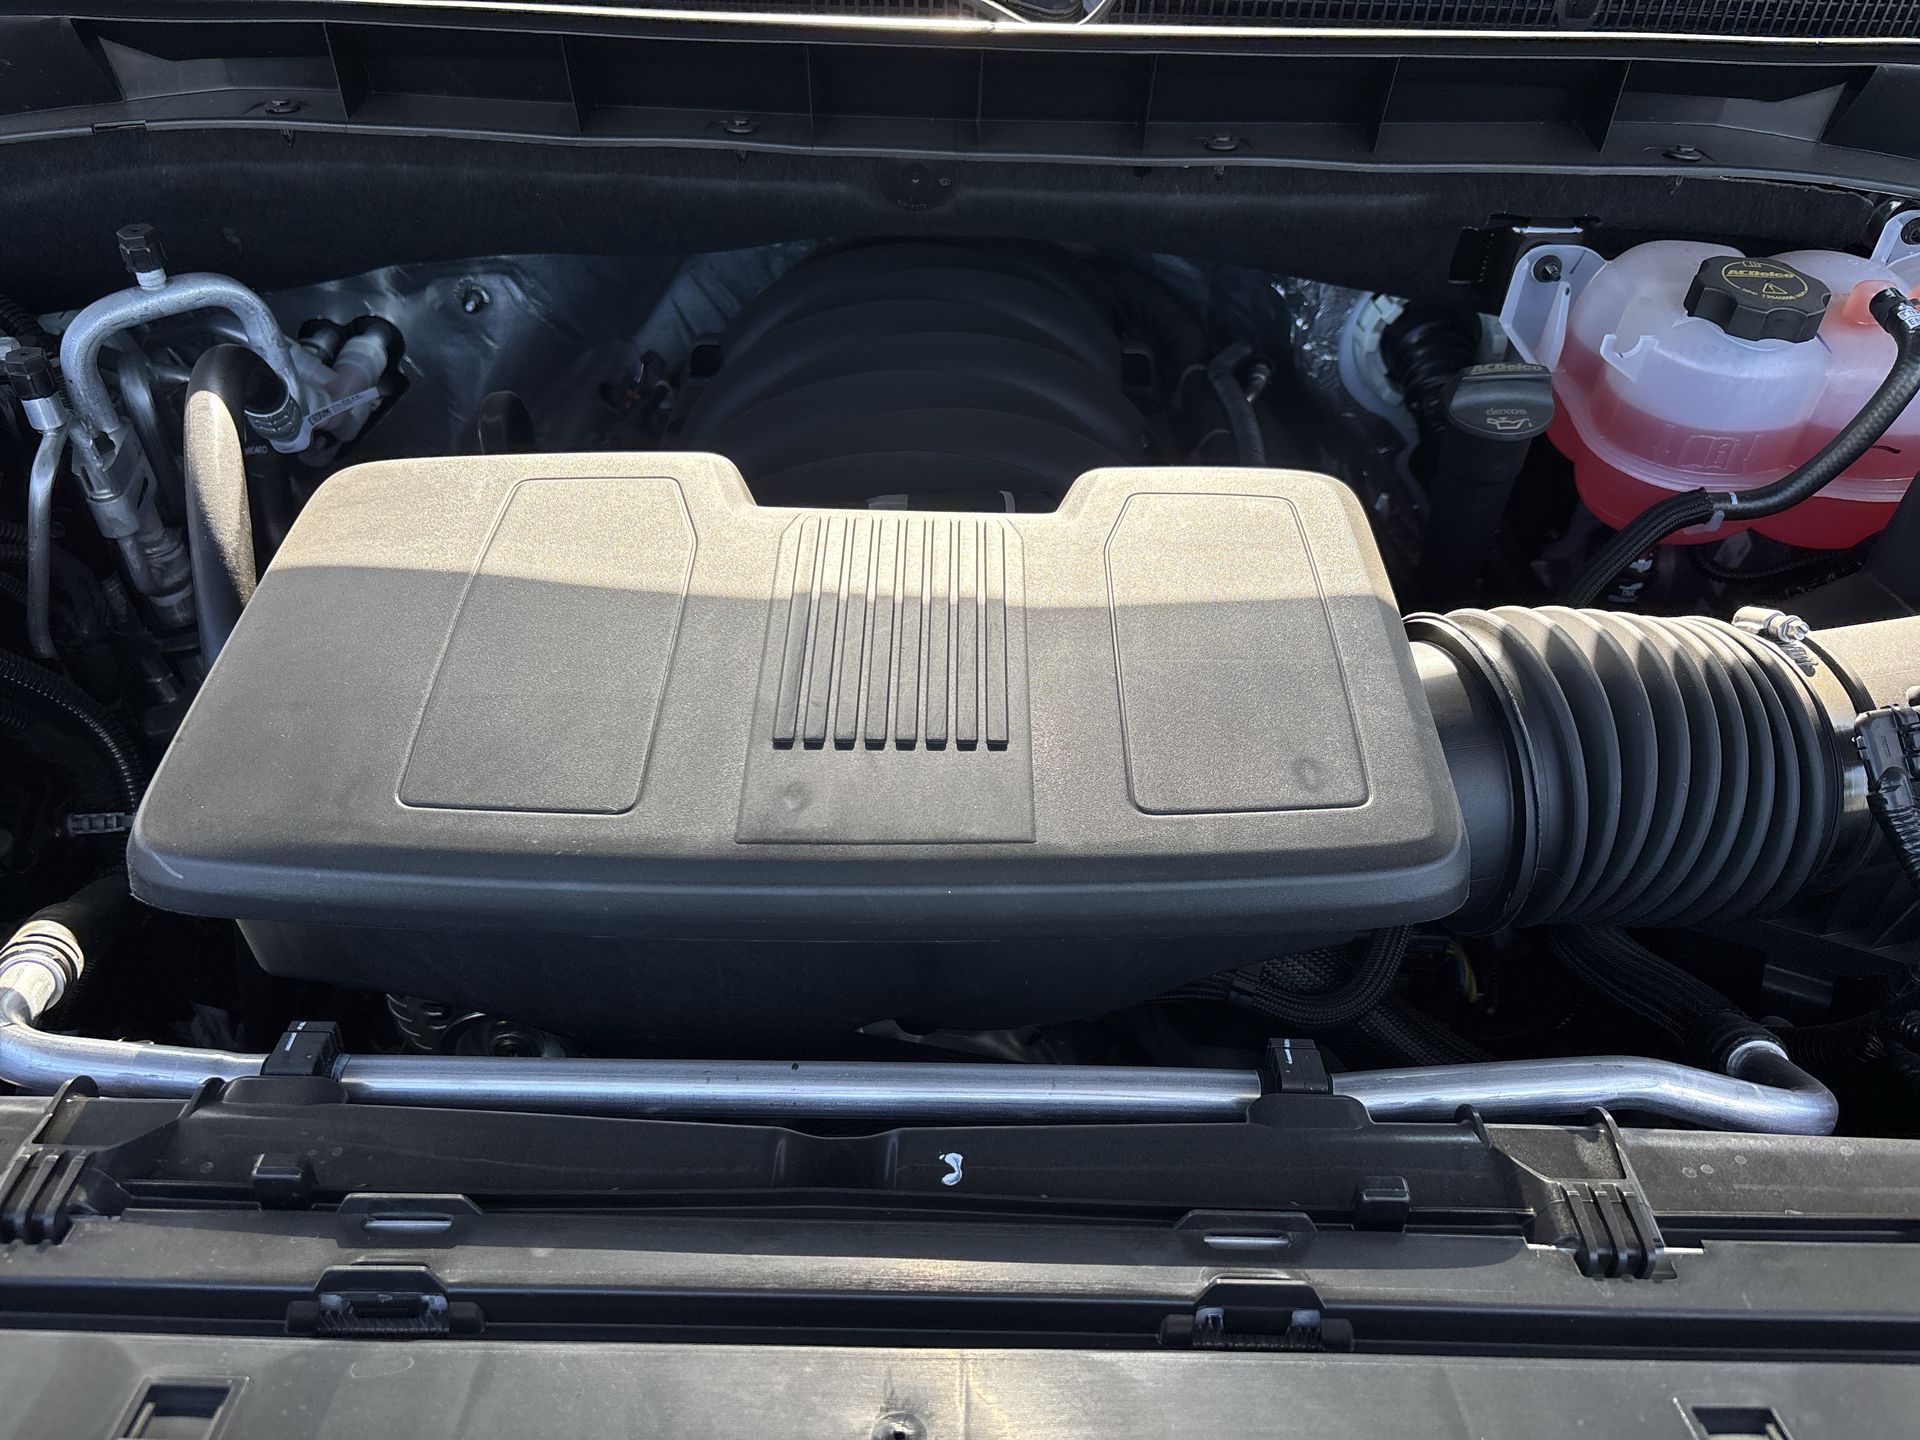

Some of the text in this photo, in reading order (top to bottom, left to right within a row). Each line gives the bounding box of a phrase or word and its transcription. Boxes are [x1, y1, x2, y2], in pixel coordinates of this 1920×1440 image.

[1727, 269, 1795, 278] ACDelco
[1471, 363, 1542, 375] ACDelco
[1486, 407, 1527, 416] dexos
